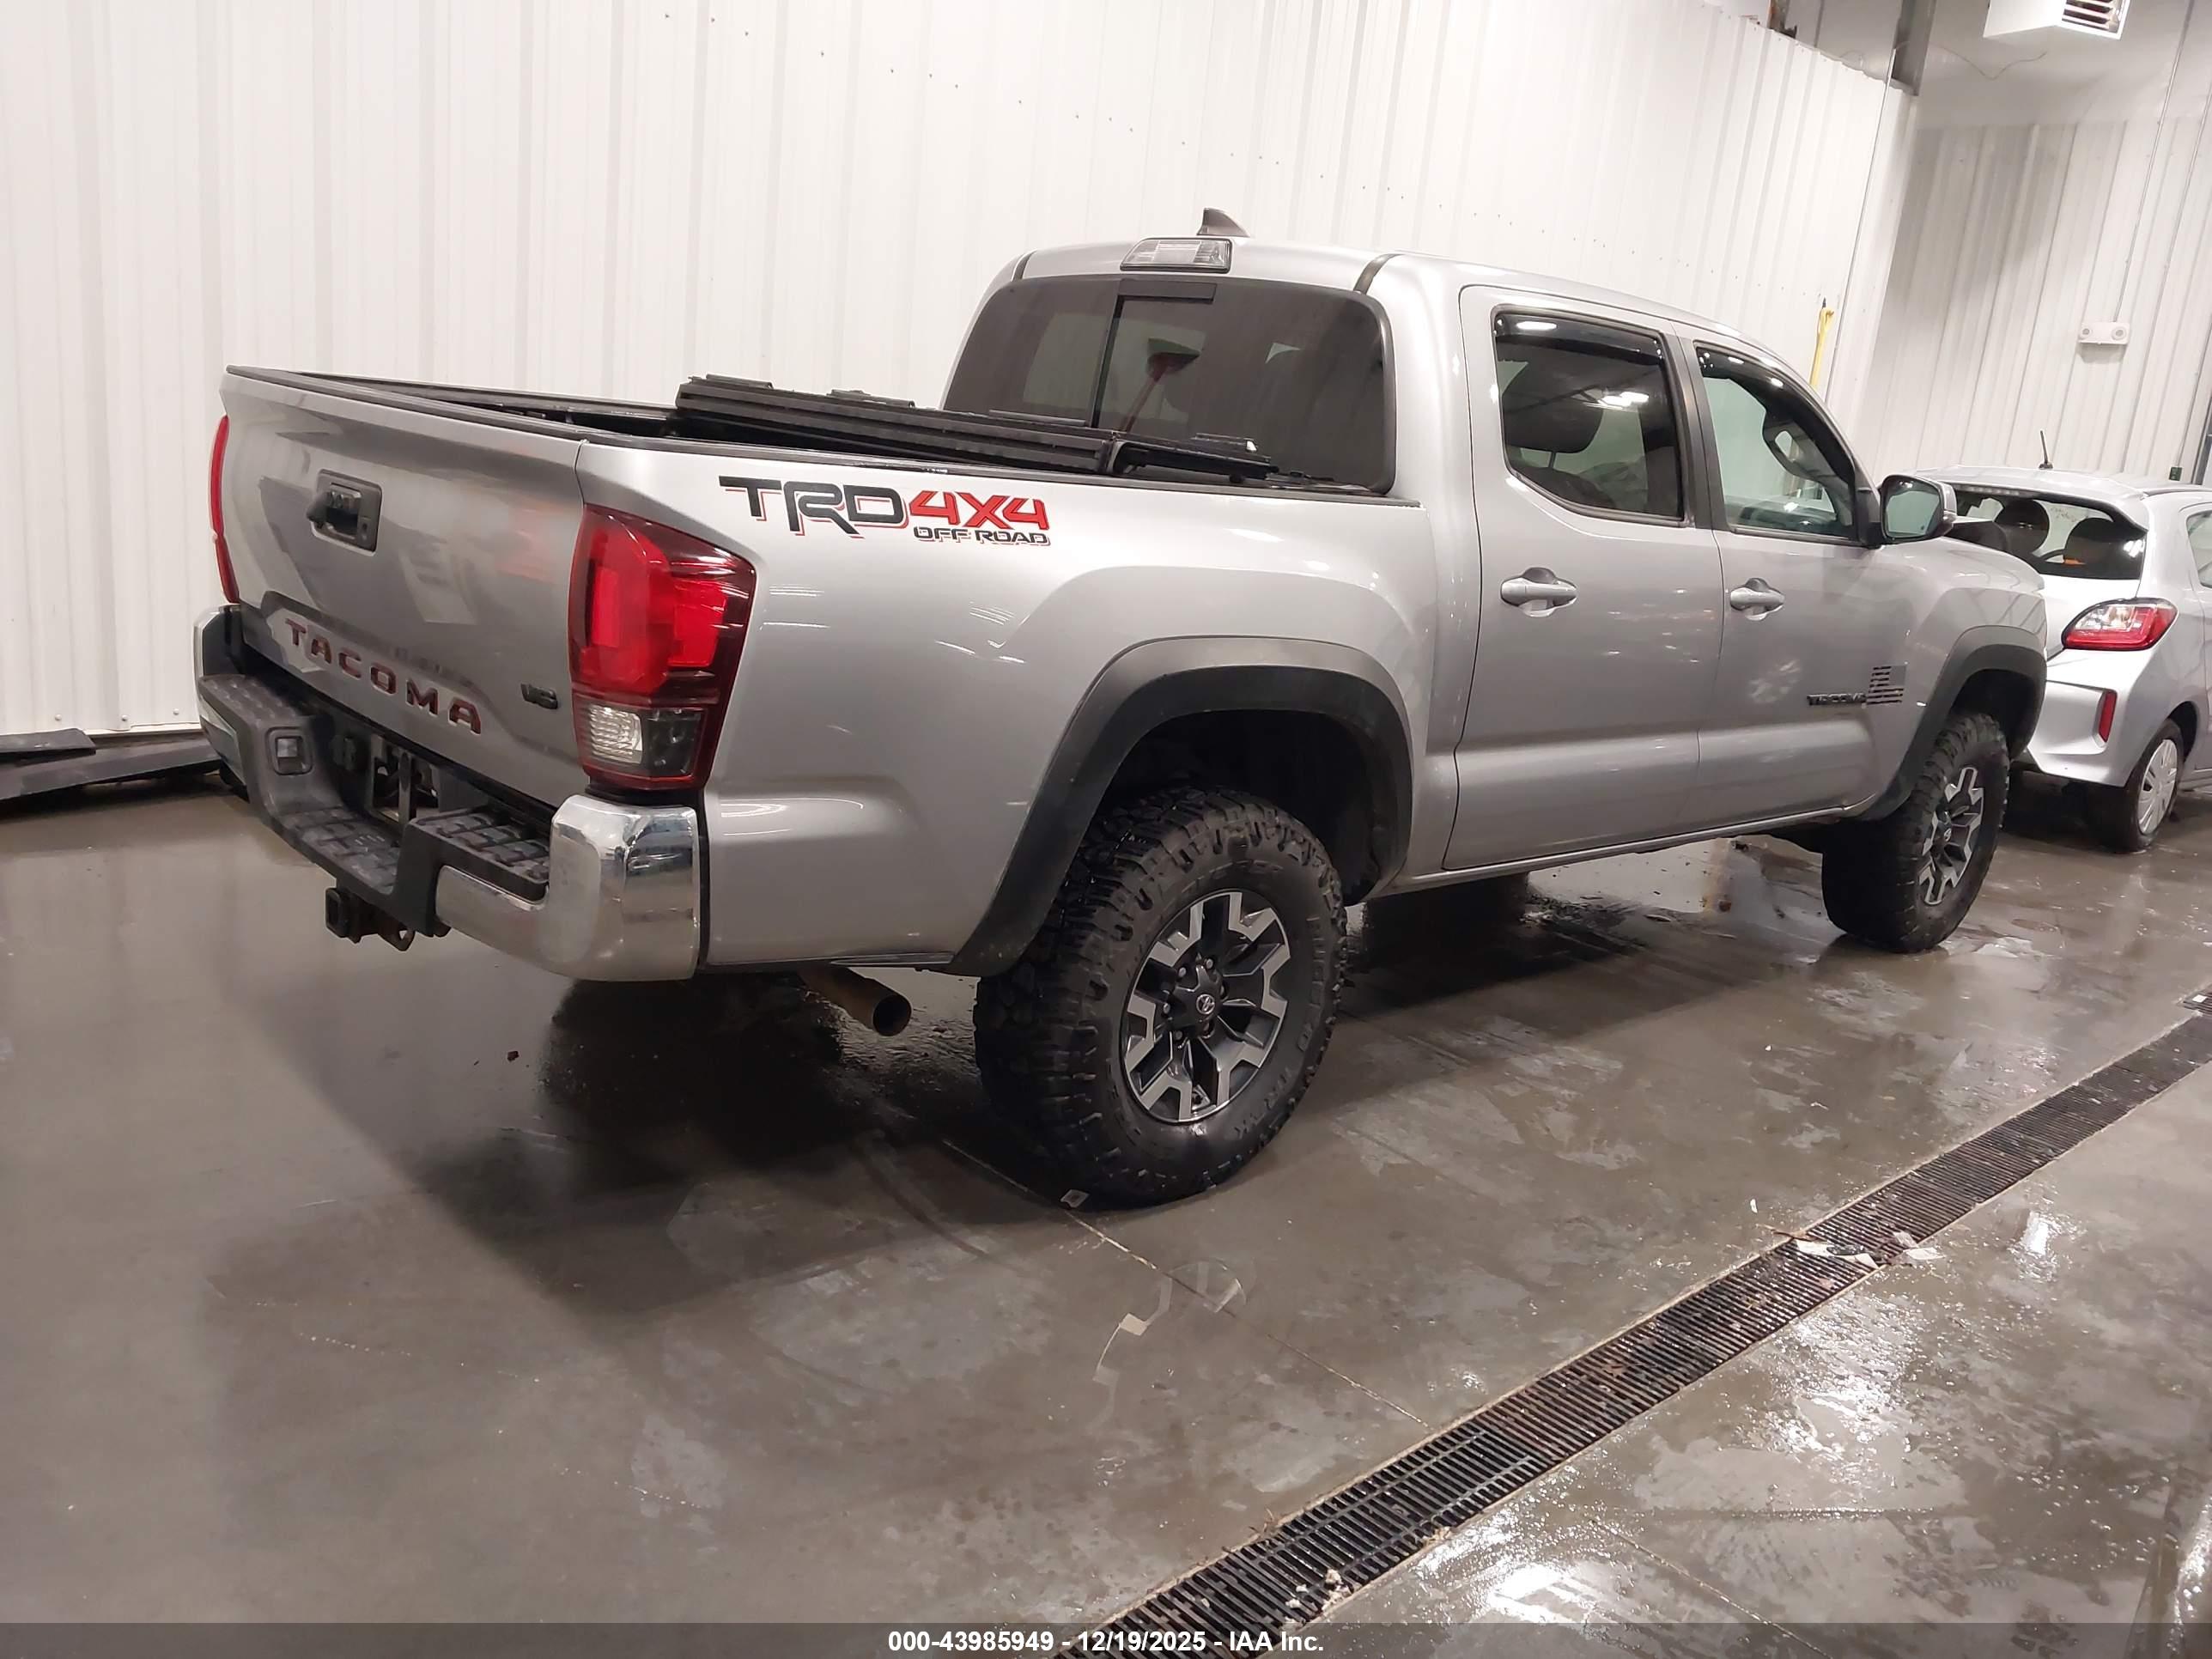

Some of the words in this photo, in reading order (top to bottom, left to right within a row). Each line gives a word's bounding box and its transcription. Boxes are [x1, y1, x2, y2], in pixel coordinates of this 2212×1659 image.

[913, 526, 970, 543] OFF
[975, 529, 1051, 546] ROAD
[284, 617, 482, 736] TACOMA
